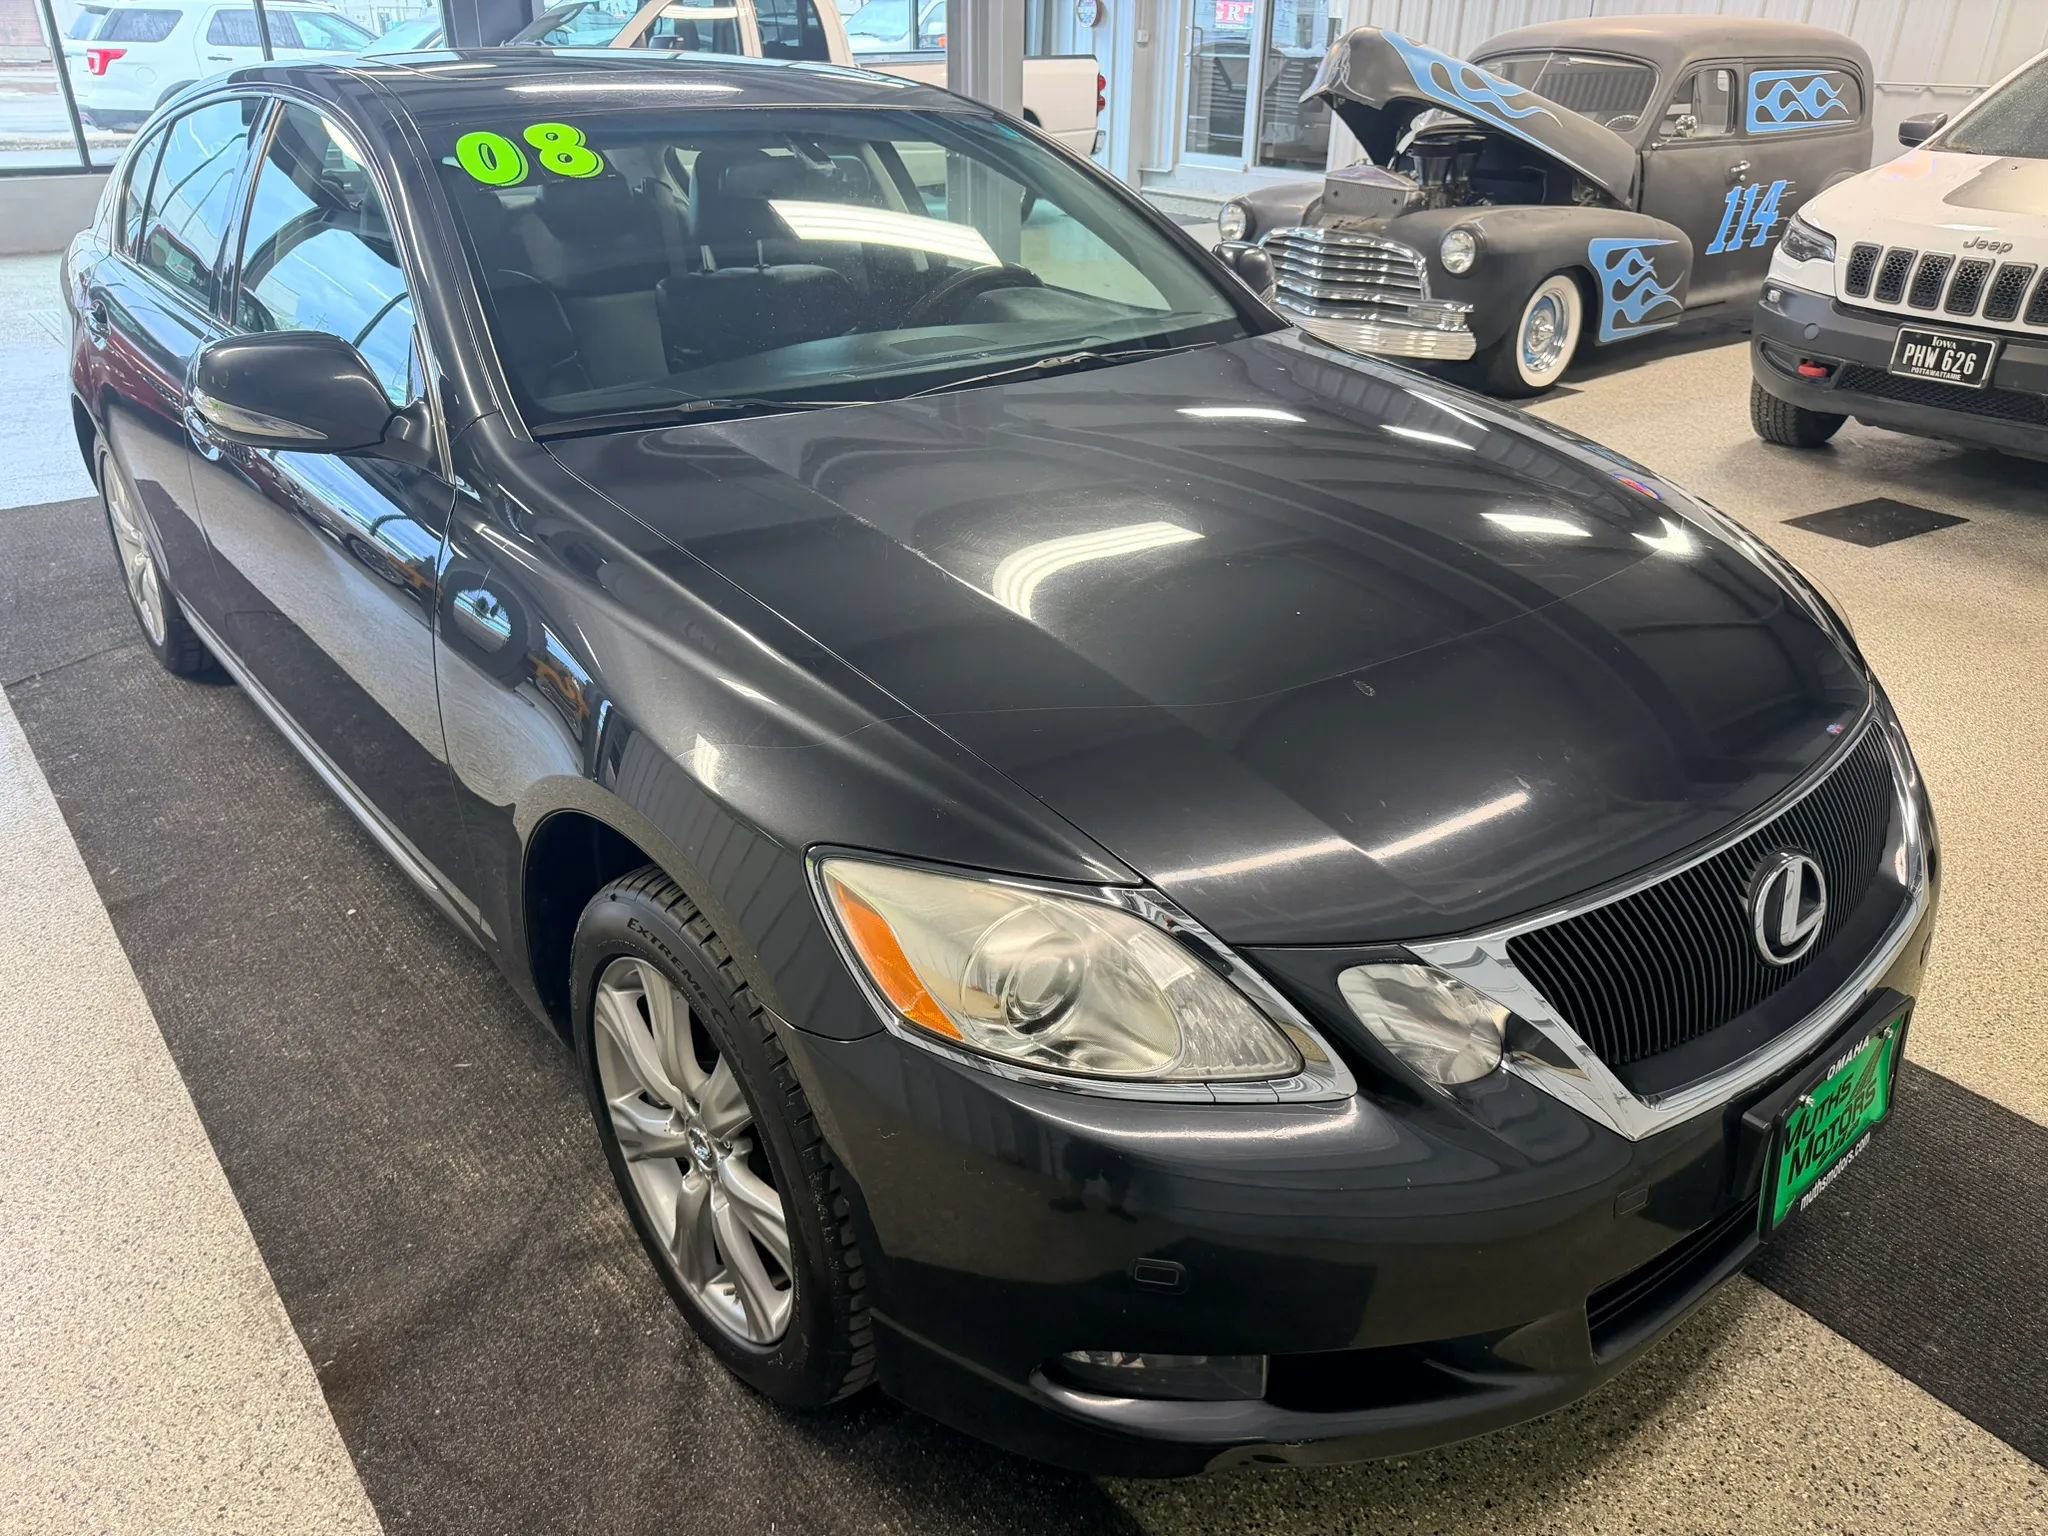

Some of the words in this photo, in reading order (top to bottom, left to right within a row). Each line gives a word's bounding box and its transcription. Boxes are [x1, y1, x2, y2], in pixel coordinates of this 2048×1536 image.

[456, 122, 604, 187] 08
[1705, 179, 1787, 255] 114
[1963, 236, 2013, 255] Jeep
[1902, 343, 1940, 369] PHW
[1941, 350, 1977, 375] 626
[1827, 1035, 1870, 1081] OMAHA
[1785, 1072, 1854, 1156] MUTHS
[1787, 1077, 1877, 1186] MOTORS
[1800, 1131, 1871, 1212] muthsmotors.com
